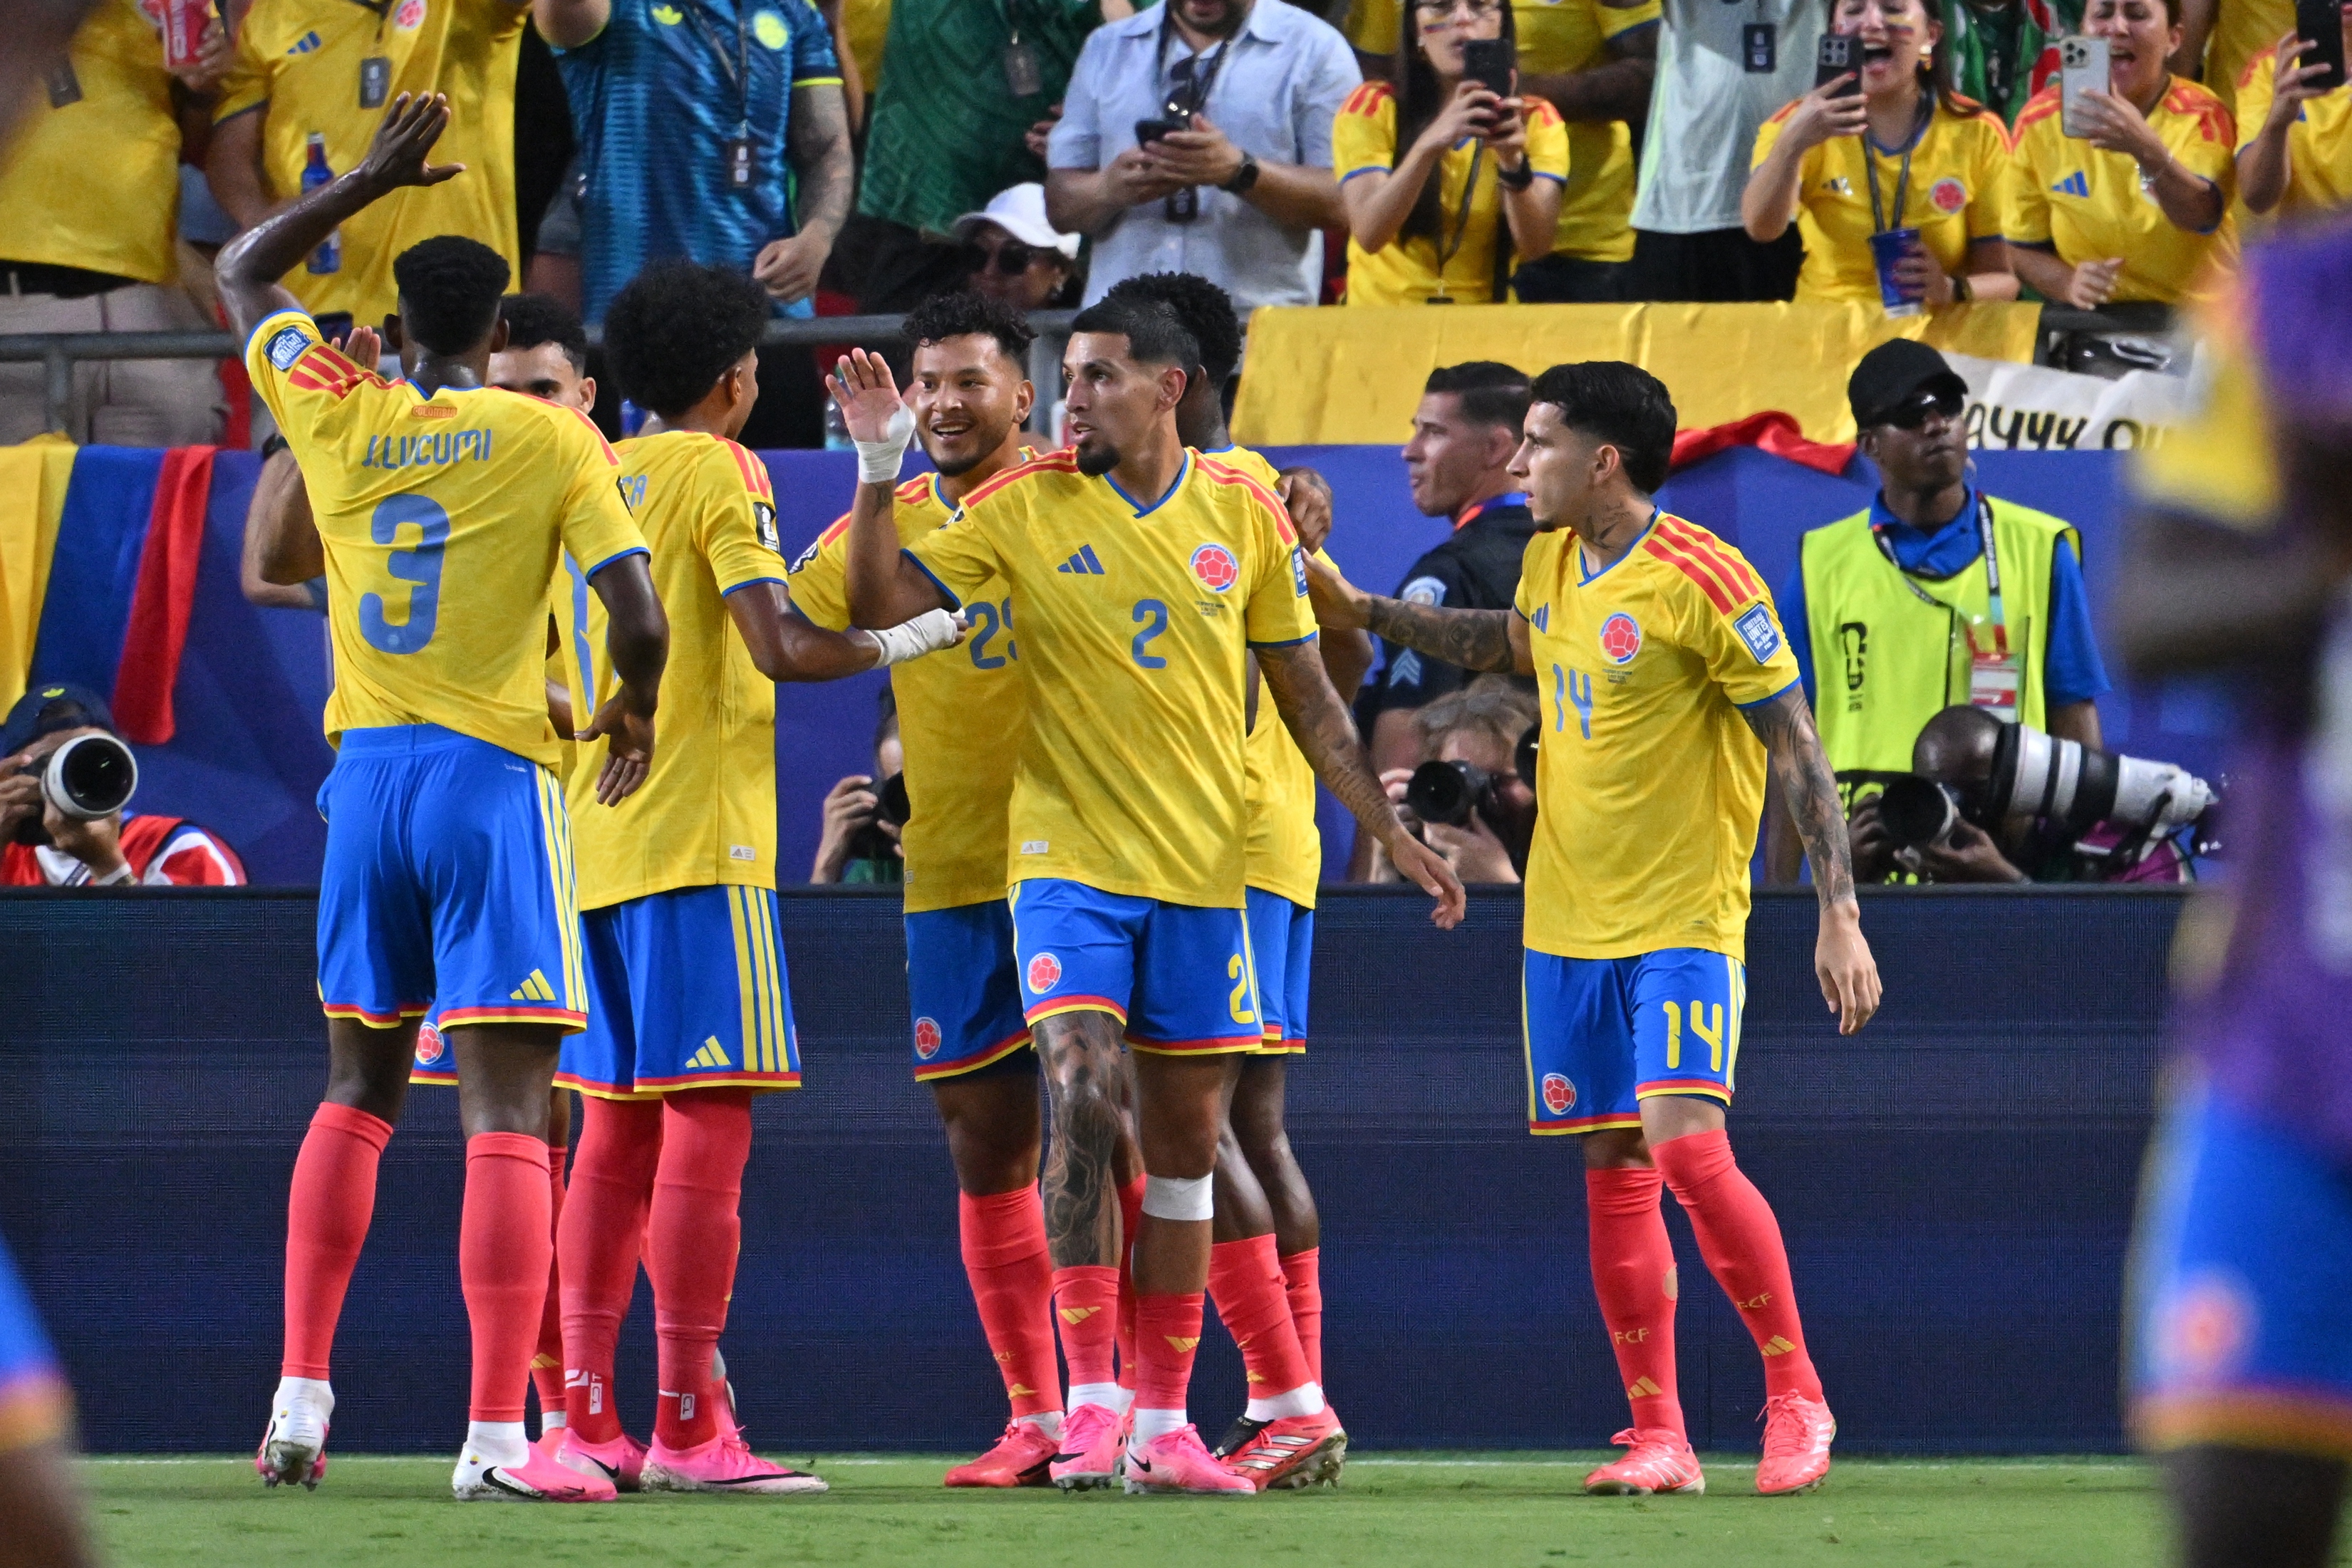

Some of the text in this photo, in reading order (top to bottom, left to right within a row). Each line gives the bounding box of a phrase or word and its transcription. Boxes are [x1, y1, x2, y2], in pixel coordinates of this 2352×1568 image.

[276, 336, 302, 360] UNITES
[413, 406, 457, 417] COLOMBIA
[362, 428, 492, 469] J.LUCUMI
[358, 494, 451, 655] 3
[1132, 598, 1168, 668] 2
[1743, 612, 1763, 632] FOOTBALL
[1747, 619, 1768, 640] UNITES
[1553, 663, 1593, 739] 14
[1228, 953, 1255, 1024] 2
[1663, 1000, 1723, 1072] 14
[1737, 1293, 1773, 1310] FCF
[1614, 1328, 1649, 1345] FCF
